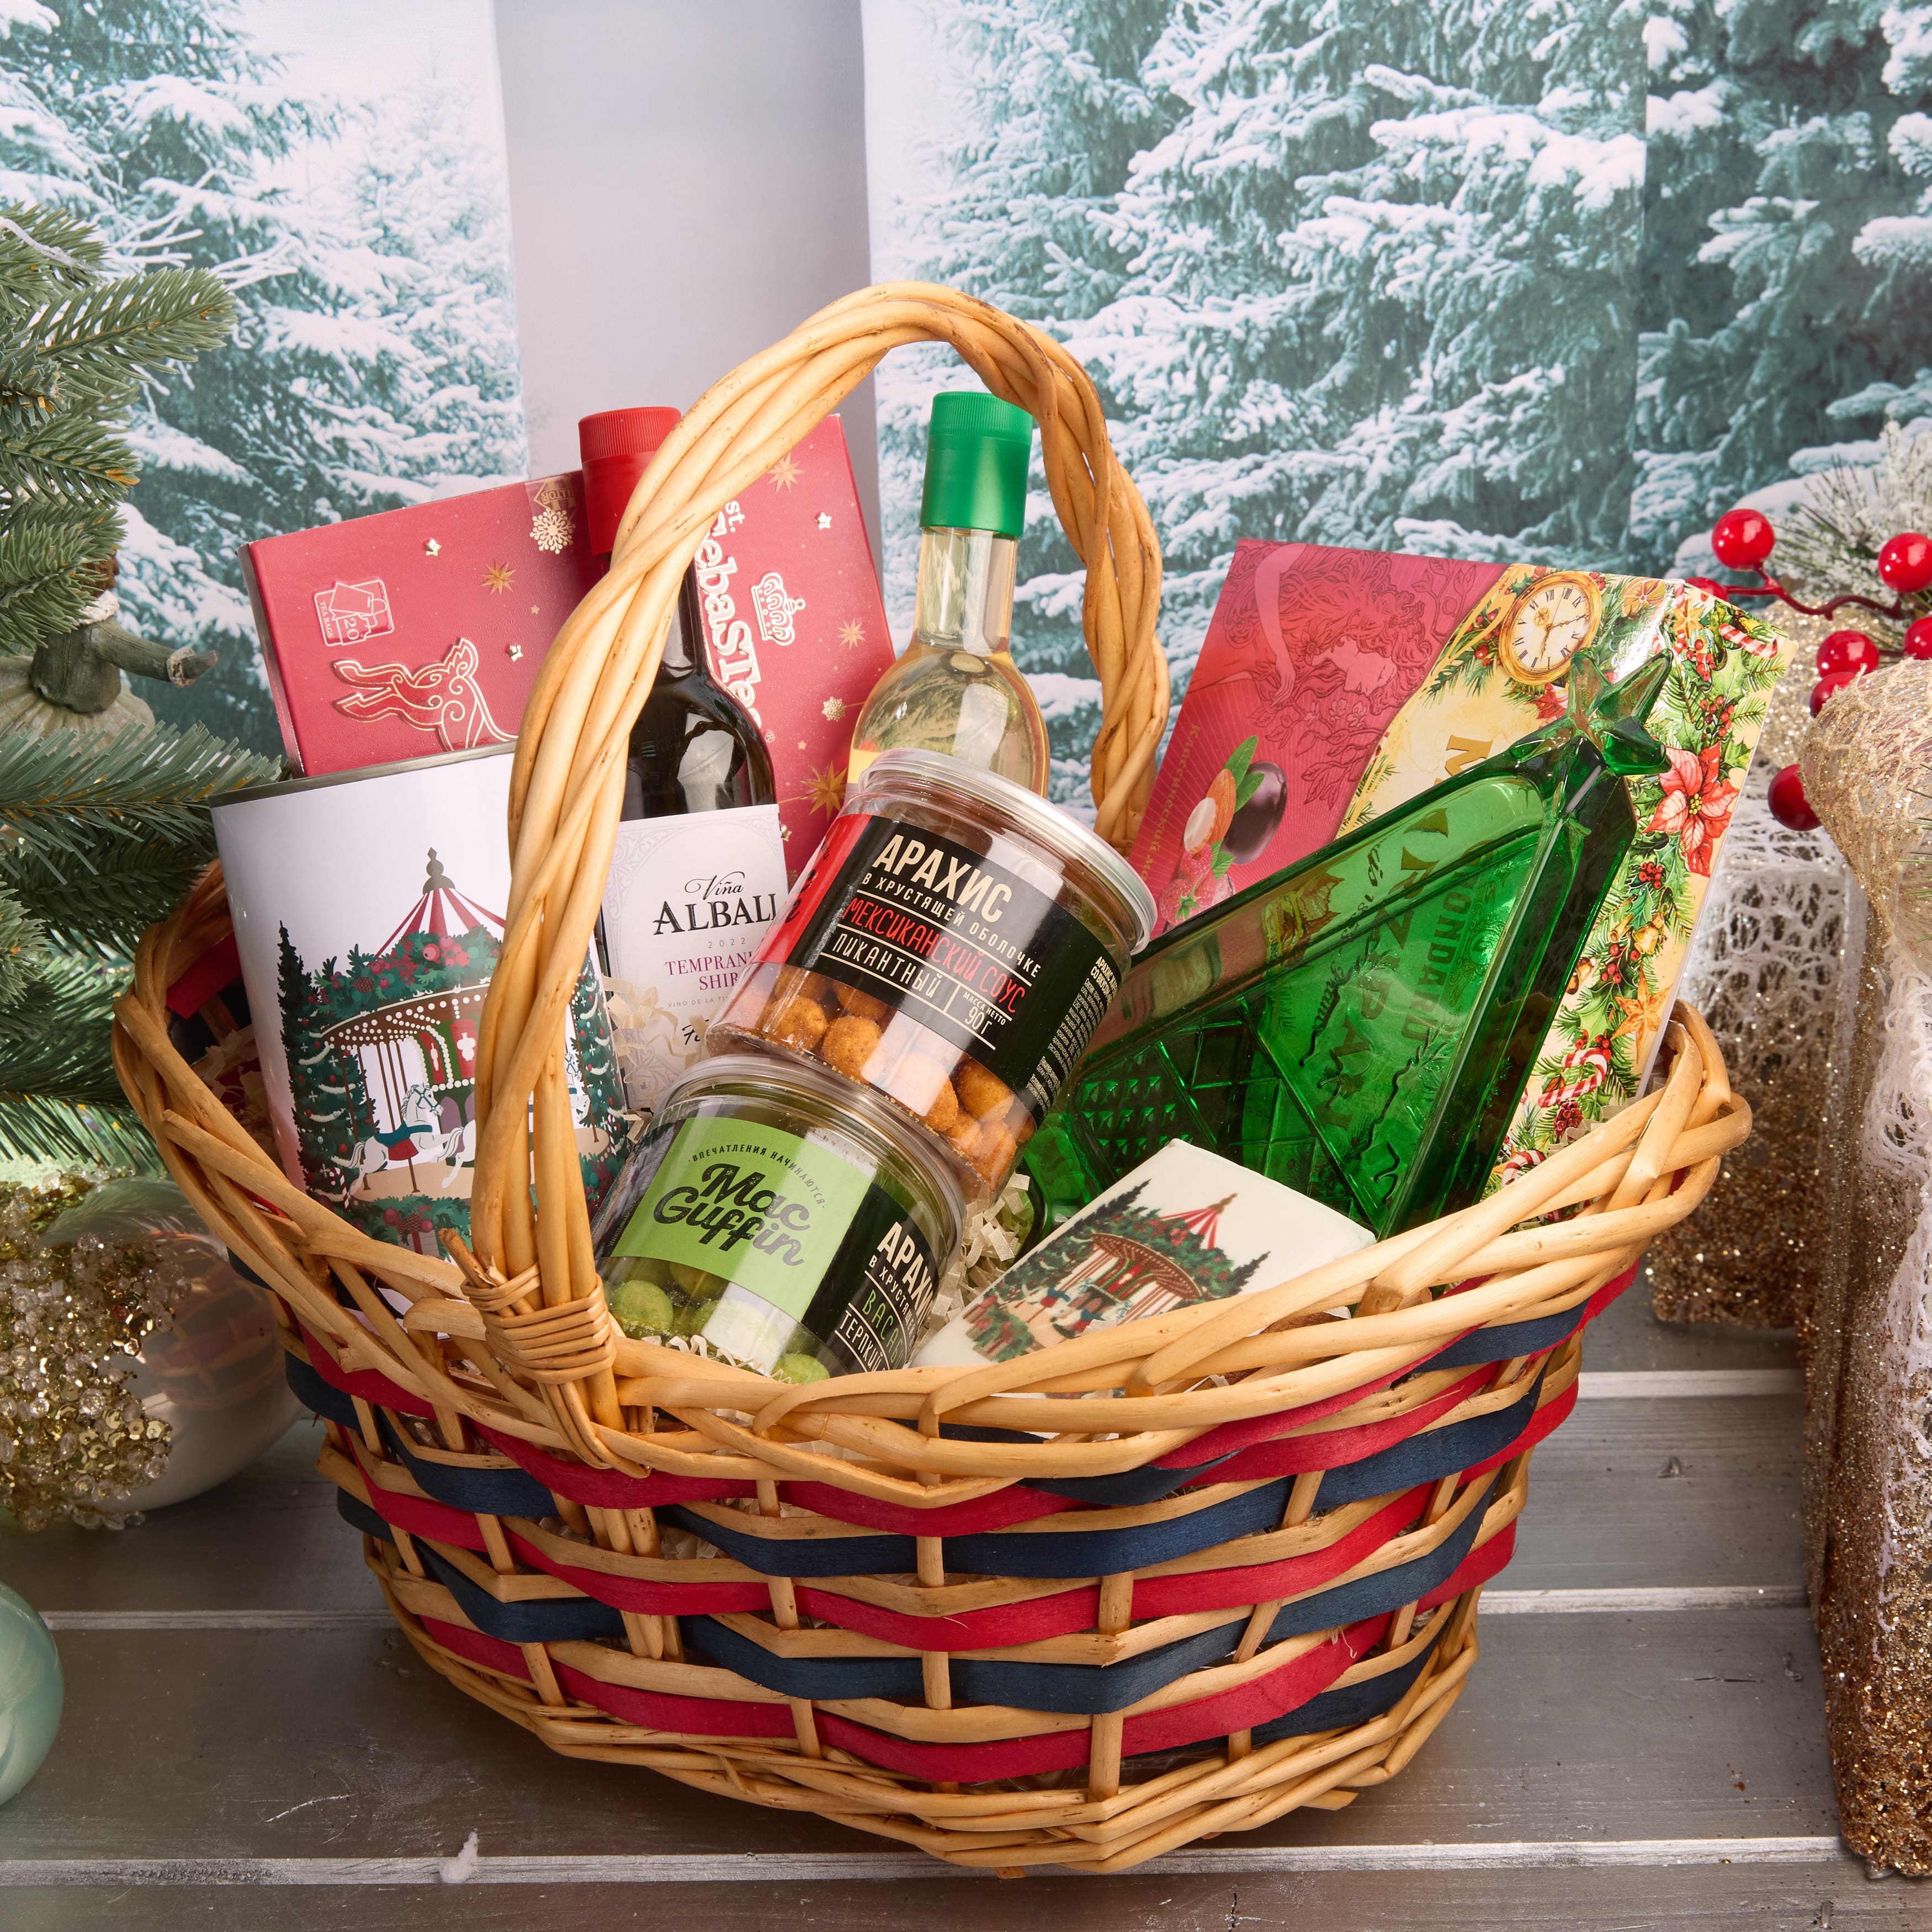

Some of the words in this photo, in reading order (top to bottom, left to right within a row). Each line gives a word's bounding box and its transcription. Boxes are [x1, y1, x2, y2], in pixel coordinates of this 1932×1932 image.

[320, 601, 328, 617] TEA
[323, 618, 333, 638] BAGS
[344, 618, 359, 640] 20
[684, 871, 745, 900] Viña
[872, 834, 1012, 923] АРАХИС
[652, 893, 777, 935] ALBALI
[862, 873, 871, 885] В
[875, 877, 967, 927] ХРУСТЯЩЕЙ
[969, 922, 1042, 978] ОБОЛОЧКЕ
[708, 937, 746, 949] 2022
[842, 897, 986, 983] МЕКСИКАНСКИЙ
[979, 967, 1026, 1013] СОУС
[832, 933, 942, 999] ПИКАНТНЫЙ
[962, 991, 986, 1012] МАССА
[985, 1006, 1006, 1026] НЕТТО
[964, 1006, 983, 1031] 90
[692, 1144, 767, 1162] ВПЕЧАТЛЕНИЯ
[770, 1151, 826, 1205] НАЧИНАЮТСЯ
[699, 1163, 811, 1231] Mac
[653, 1186, 805, 1266] Guffin
[868, 1255, 878, 1268] В
[840, 1310, 884, 1372] ТЕРПКИЙ
